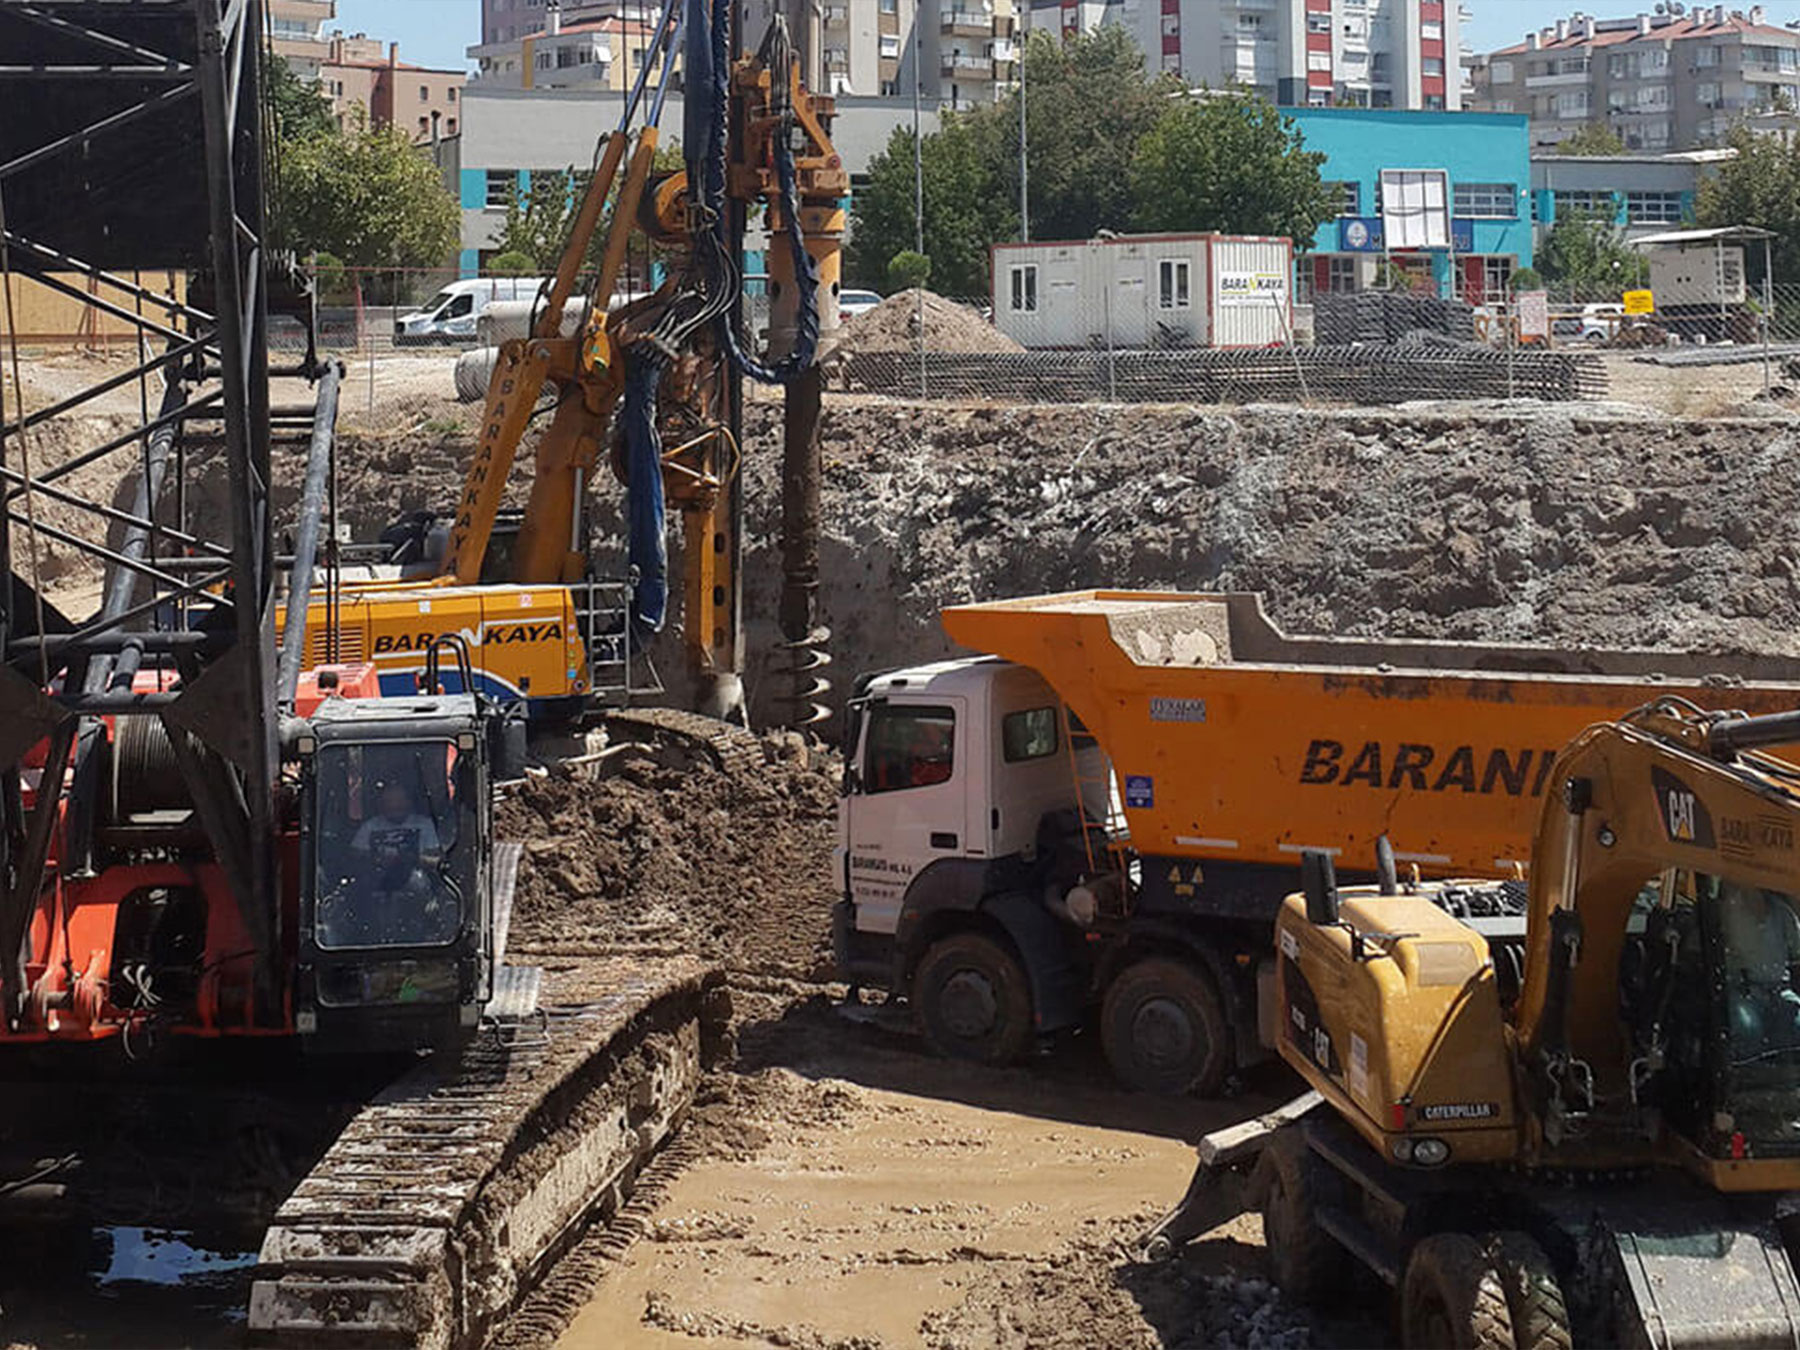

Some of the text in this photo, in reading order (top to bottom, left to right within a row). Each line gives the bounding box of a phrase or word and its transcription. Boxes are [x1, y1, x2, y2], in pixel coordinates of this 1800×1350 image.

[1221, 277, 1283, 291] BARANKAYA
[1669, 789, 1695, 840] CAT
[1424, 1103, 1491, 1119] CATERPILLAR
